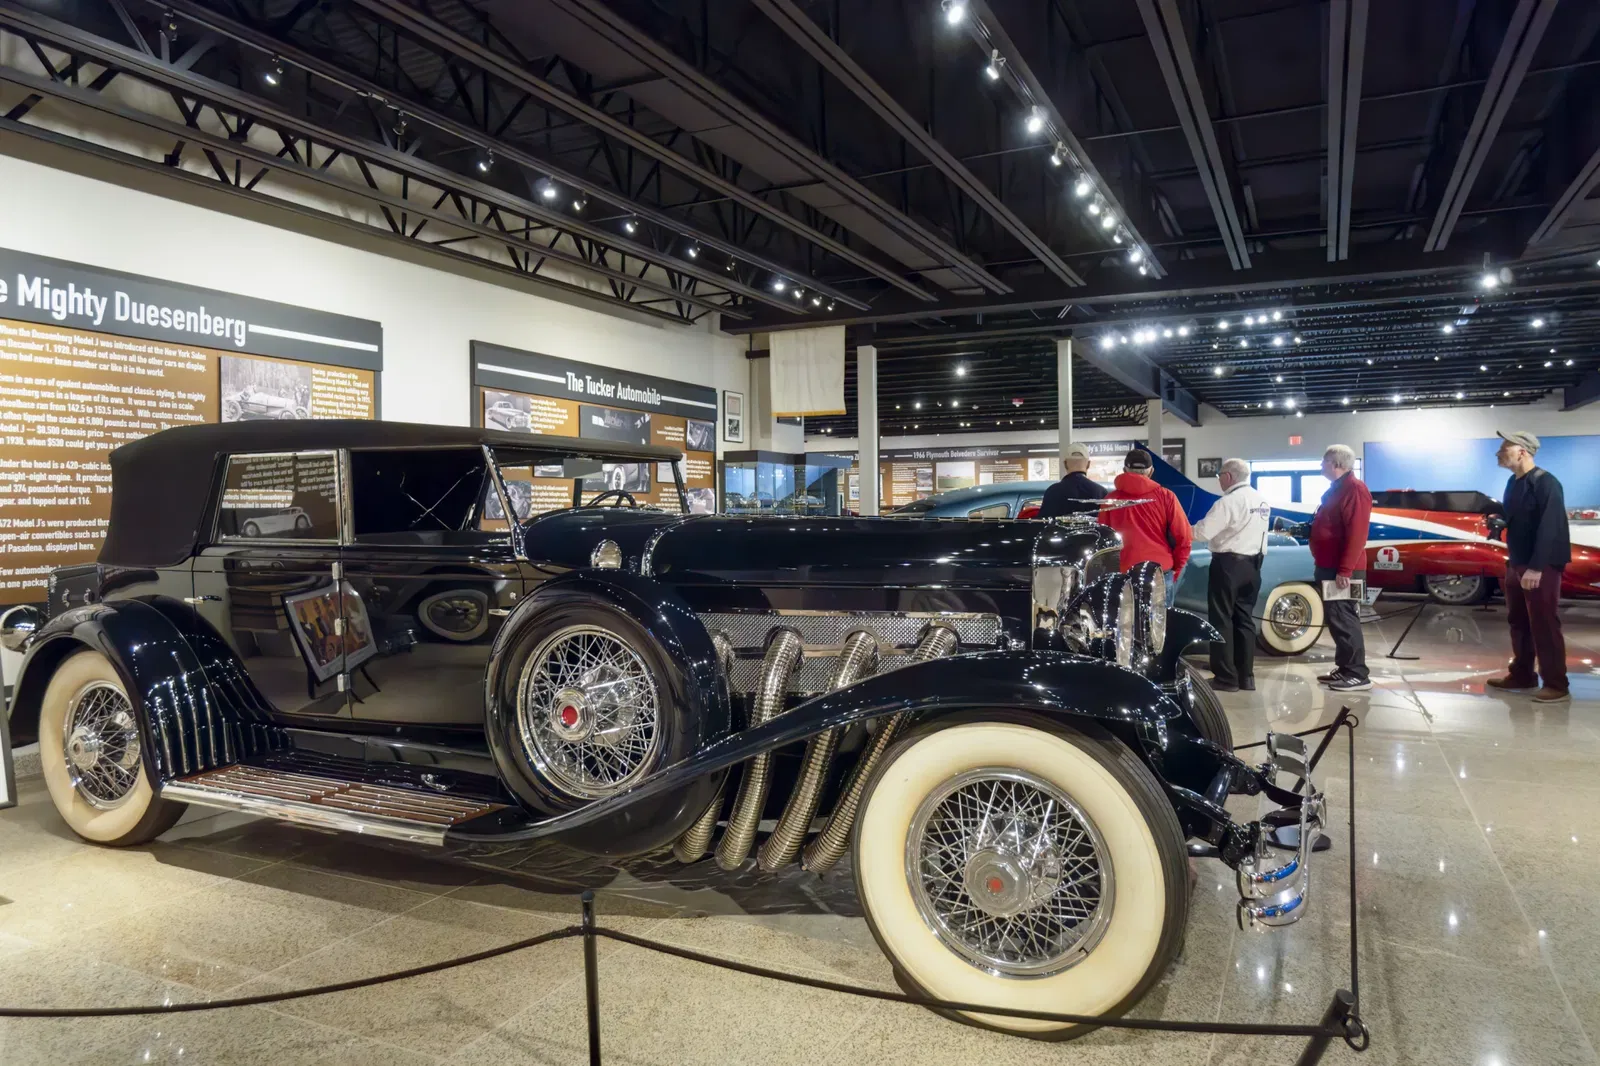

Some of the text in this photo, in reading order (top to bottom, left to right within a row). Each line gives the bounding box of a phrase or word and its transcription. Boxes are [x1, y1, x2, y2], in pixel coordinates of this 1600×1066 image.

[17, 273, 107, 325] Mighty
[115, 291, 246, 347] Duesenberg
[566, 372, 661, 405] The Tucker Automobile
[913, 451, 925, 459] 1966
[926, 451, 949, 459] Plymouth
[977, 449, 999, 457] Survivor
[13, 519, 35, 527] Model
[66, 519, 96, 528] produced
[31, 531, 73, 540] convertibles
[46, 543, 77, 553] displayed
[22, 579, 48, 589] packag
